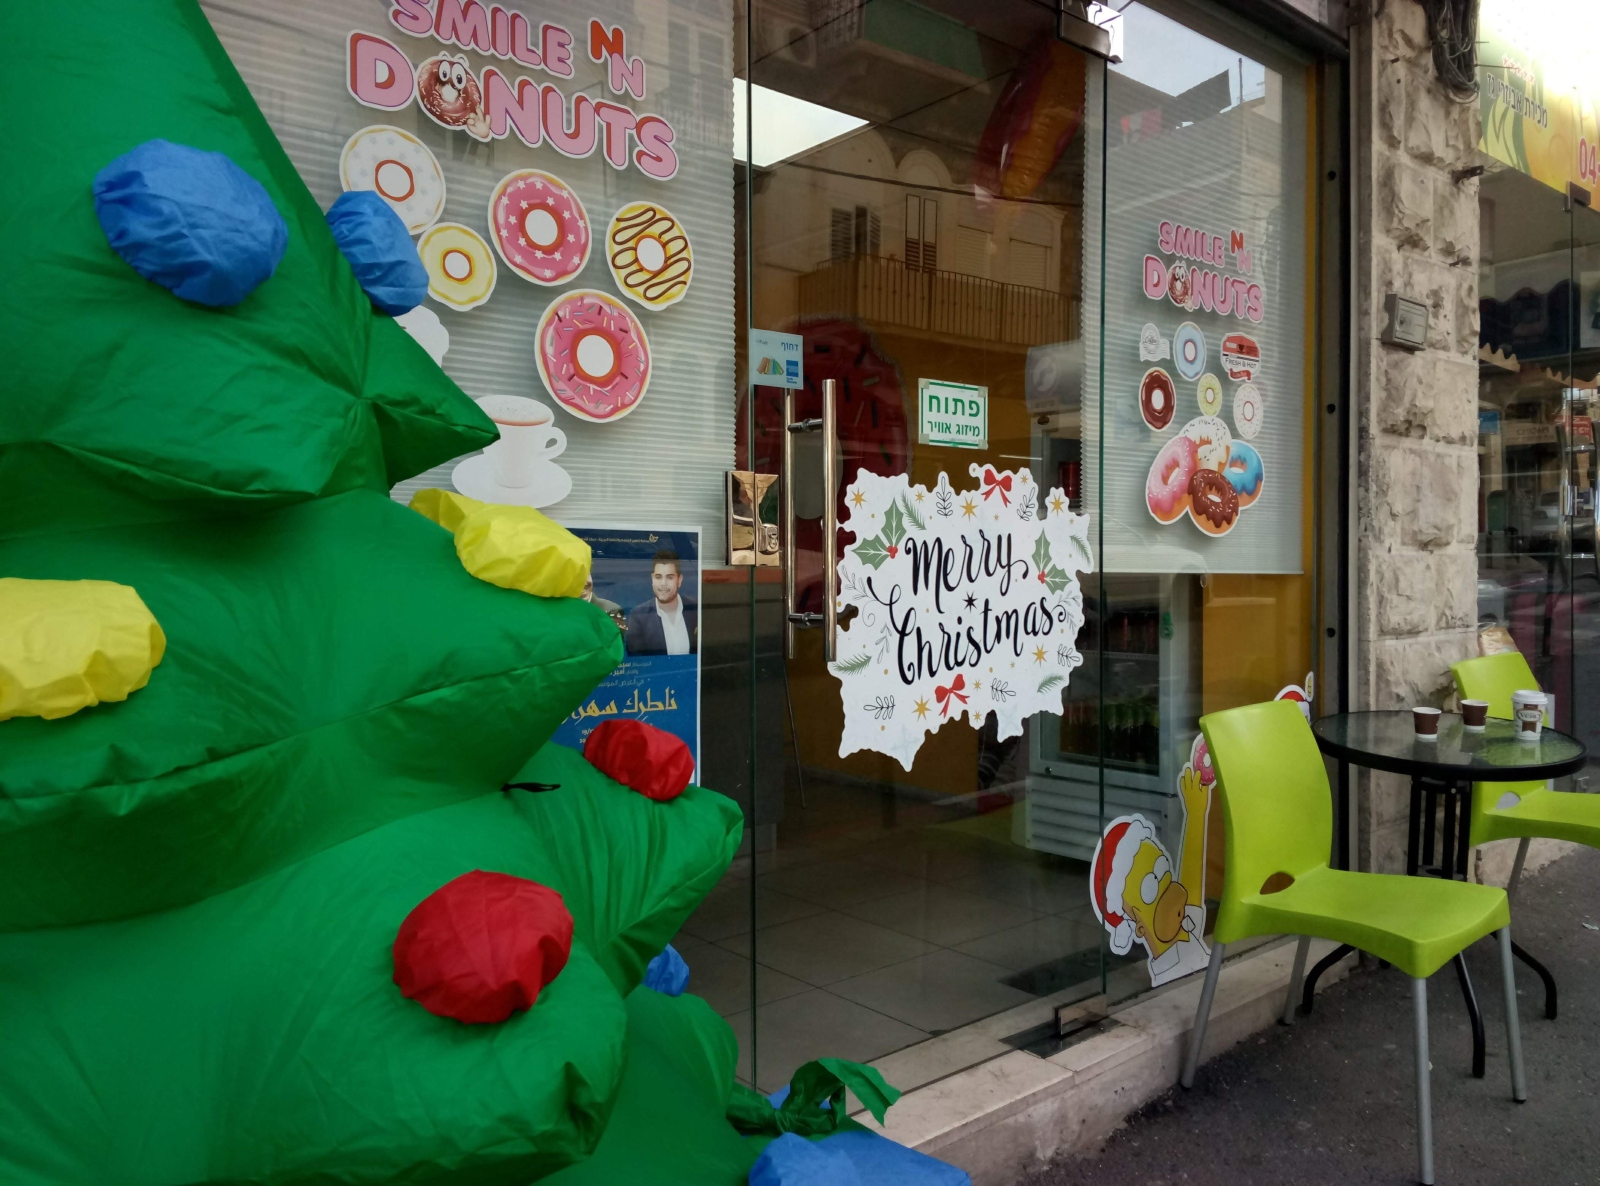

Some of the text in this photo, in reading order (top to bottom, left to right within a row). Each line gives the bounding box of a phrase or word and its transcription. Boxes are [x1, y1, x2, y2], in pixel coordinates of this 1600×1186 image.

[392, 0, 573, 76] SMILE
[349, 32, 678, 178] DONUTS
[1159, 222, 1224, 267] SMILE
[1144, 255, 1264, 322] DONUTS
[780, 341, 799, 351] דחוף
[1225, 357, 1241, 366] FRESH
[927, 420, 981, 437] מיזוג אוויר
[928, 394, 980, 417] פתוח
[904, 529, 1029, 614] Merry
[867, 577, 1067, 686] Christmas
